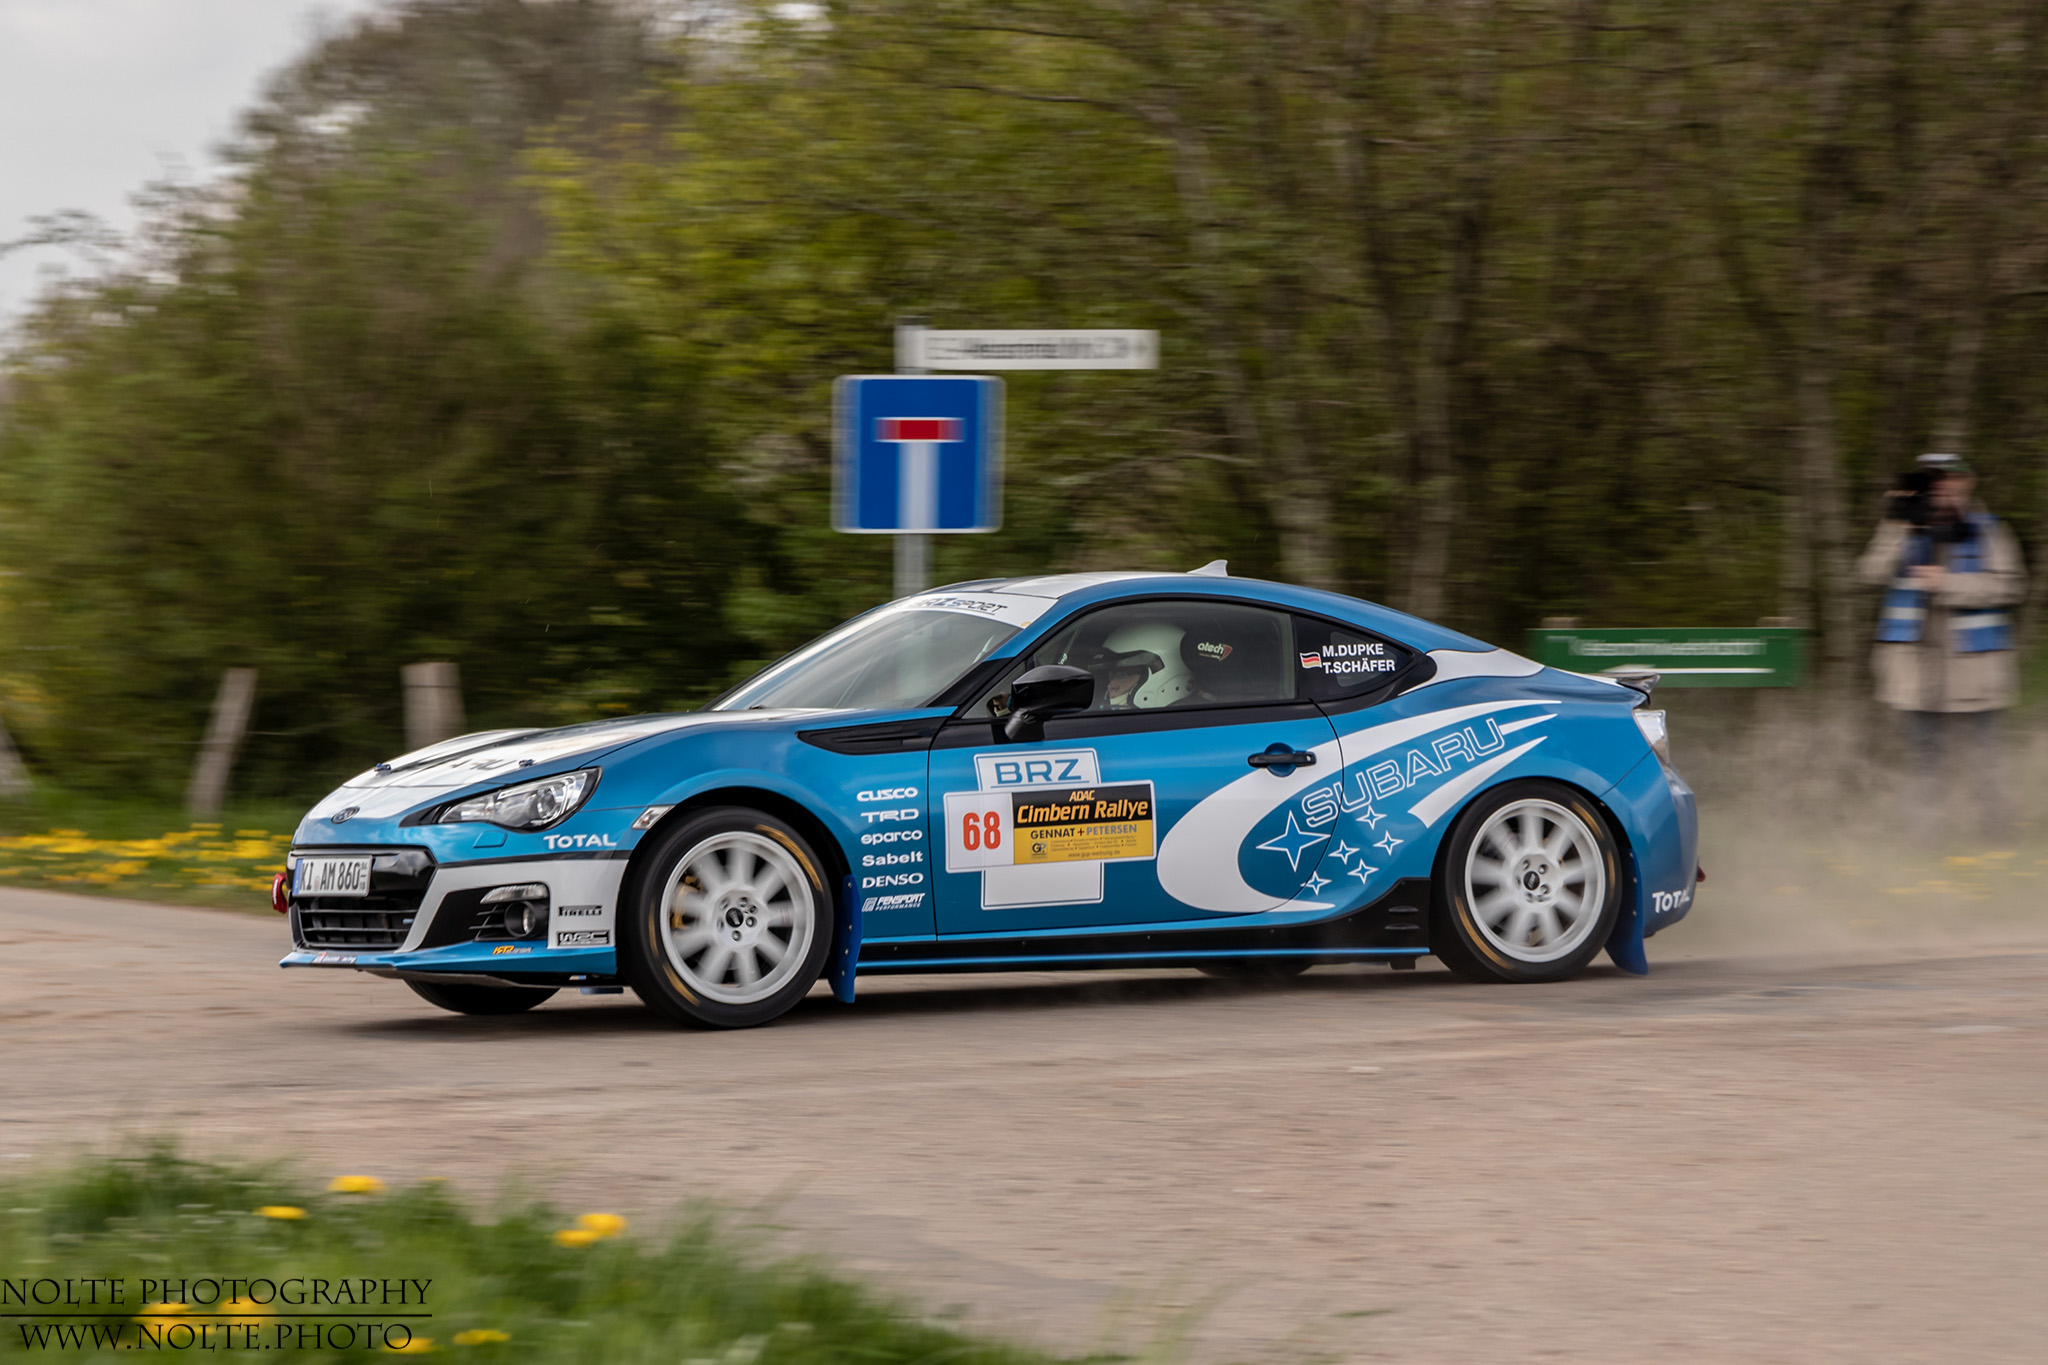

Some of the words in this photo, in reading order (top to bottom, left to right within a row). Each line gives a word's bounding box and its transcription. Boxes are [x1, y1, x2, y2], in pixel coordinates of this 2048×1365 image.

[1322, 643, 1384, 658] M.DUPKE
[1322, 657, 1396, 674] T.SCHÄFER
[995, 758, 1083, 785] BRZ
[1300, 717, 1506, 829] SUBARU
[856, 787, 919, 802] CUSCO
[1069, 789, 1096, 802] ADAC
[860, 808, 920, 823] TRD
[1017, 803, 1090, 824] Cimbern
[1094, 799, 1149, 820] Rallye
[860, 830, 923, 846] sparco
[962, 811, 1002, 851] 68
[1030, 828, 1076, 840] GENNAT
[1086, 824, 1137, 836] PETERSEN
[543, 833, 617, 850] TOTAL
[862, 851, 924, 867] Sabelt
[299, 861, 314, 891] KI
[320, 861, 336, 890] AM
[337, 861, 360, 890] 860
[862, 872, 924, 889] DENSO
[558, 904, 602, 918] PIRELLI
